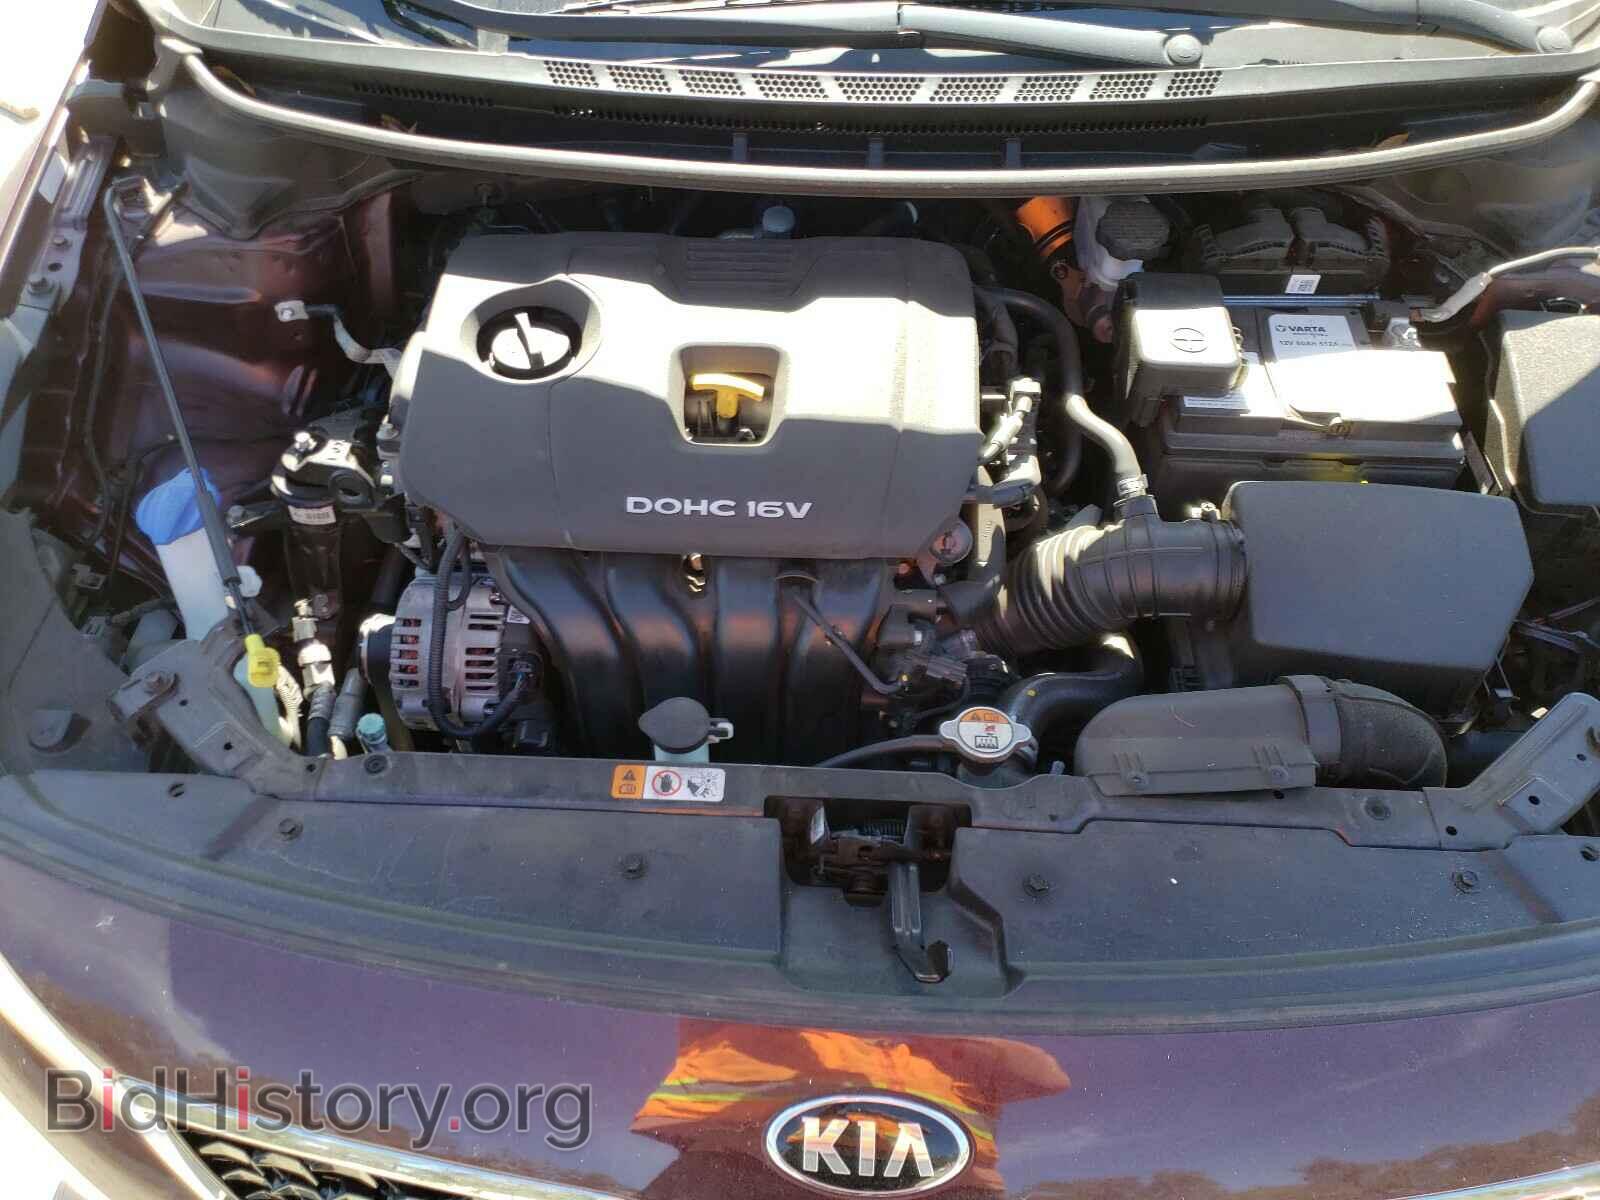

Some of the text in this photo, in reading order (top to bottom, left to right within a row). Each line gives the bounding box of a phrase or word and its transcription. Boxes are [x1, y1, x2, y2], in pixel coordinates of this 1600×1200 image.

[626, 496, 812, 519] DOHC 16V
[801, 1116, 935, 1177] KIA
